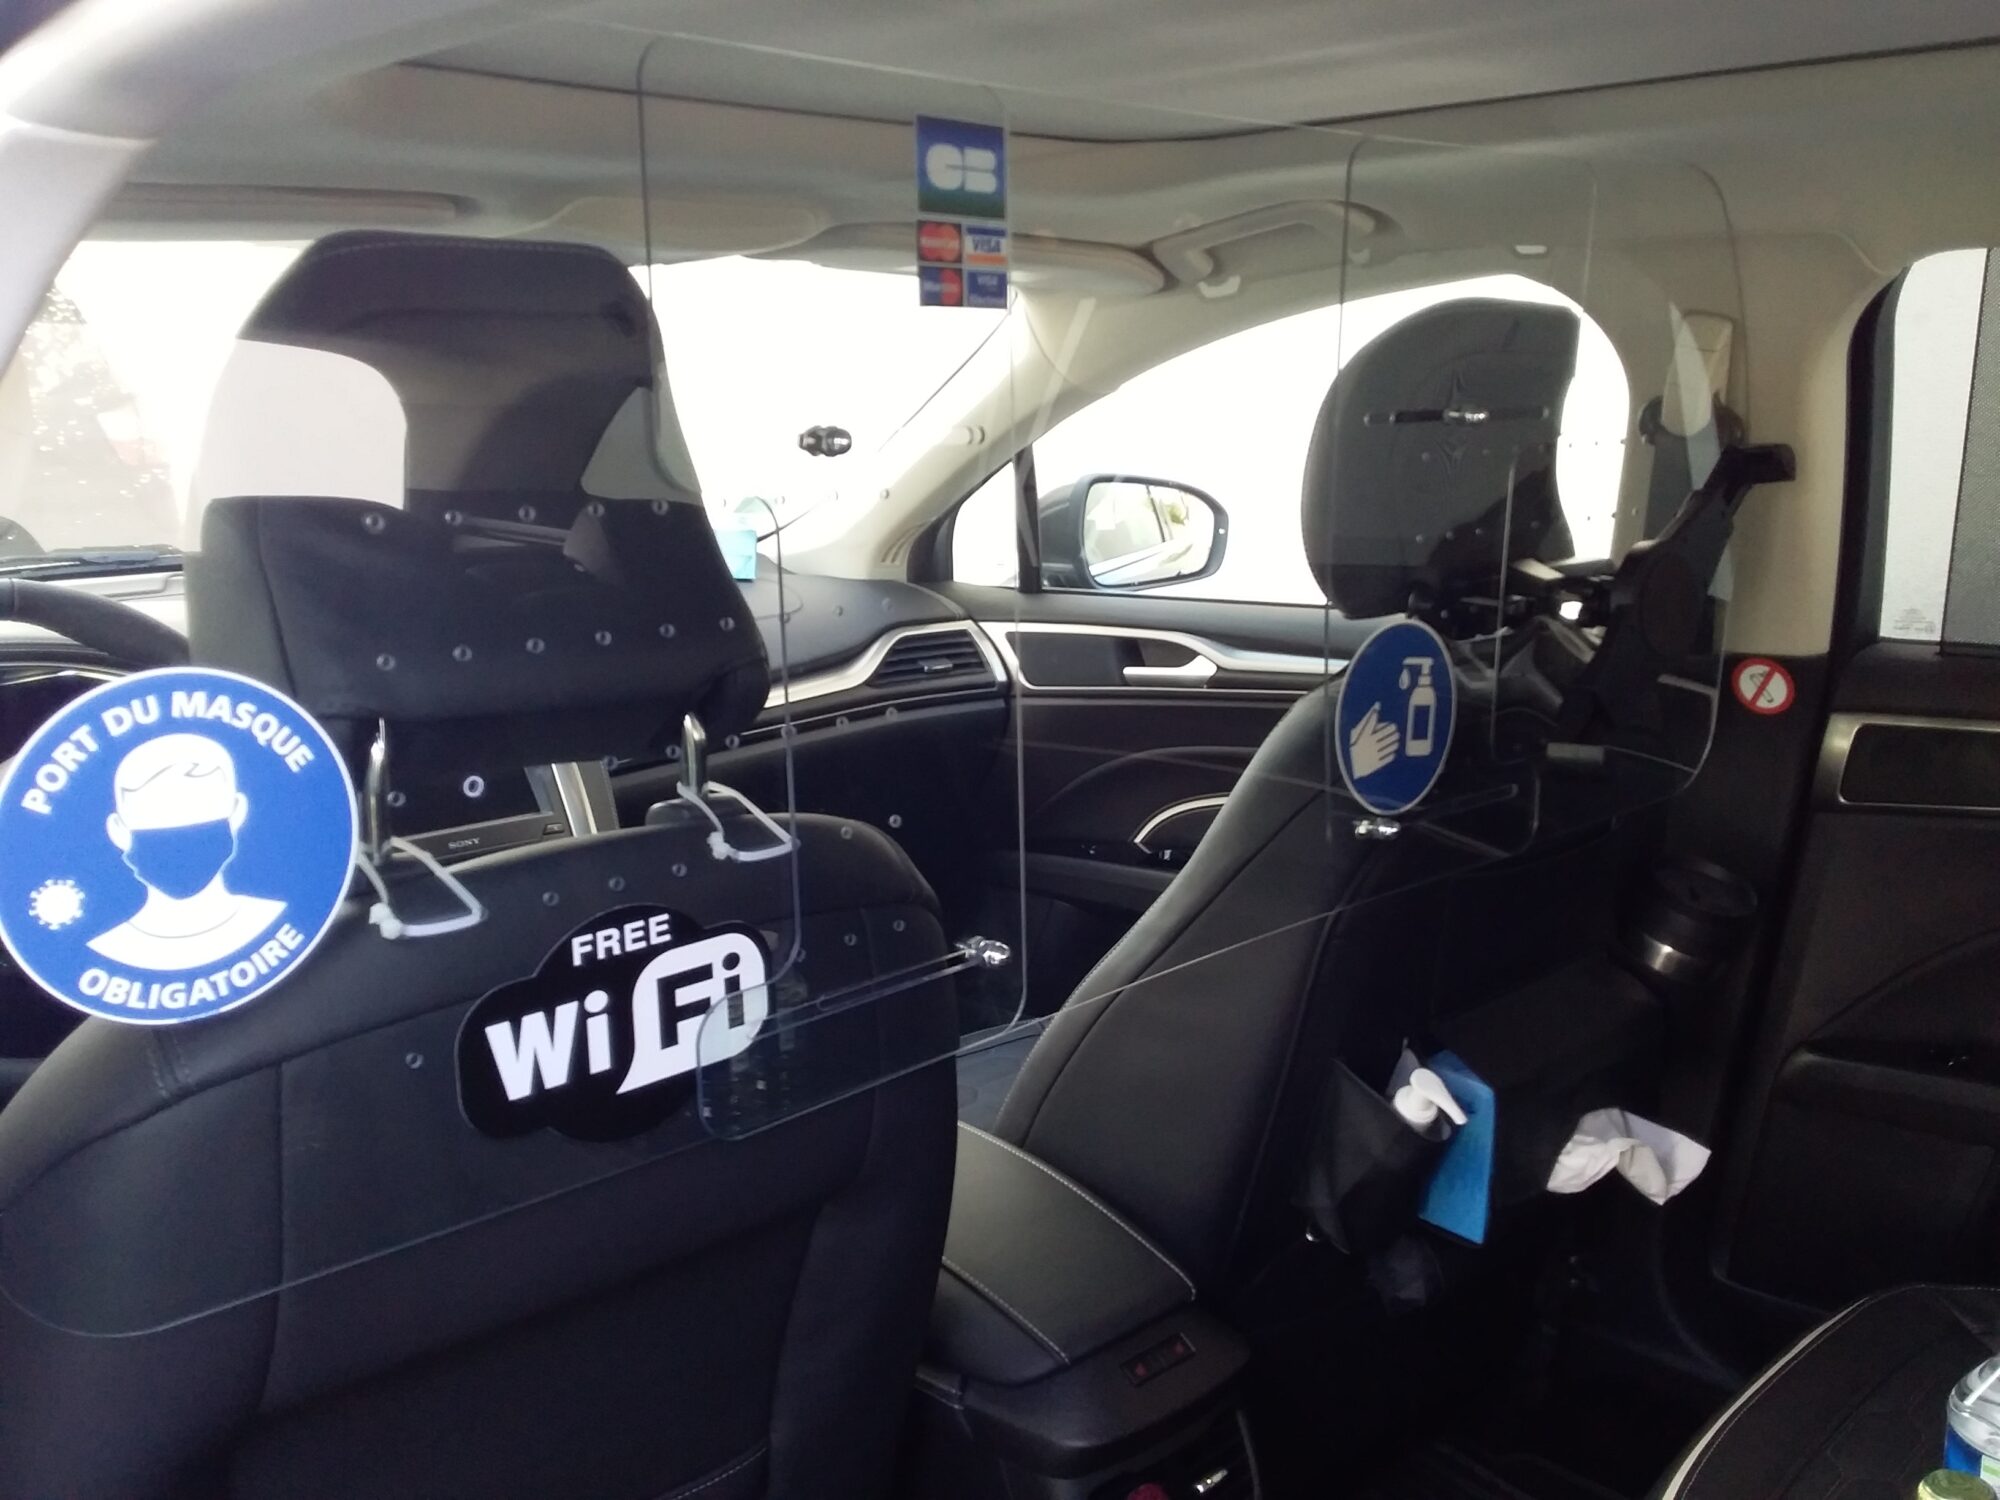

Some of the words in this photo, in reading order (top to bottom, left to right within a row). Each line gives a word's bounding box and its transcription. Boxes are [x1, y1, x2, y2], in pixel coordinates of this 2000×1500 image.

[972, 236, 1002, 253] VISA
[21, 724, 101, 815] PORT
[101, 694, 161, 738] DU
[170, 690, 316, 774] MASQUE
[447, 837, 481, 850] SONY
[78, 923, 306, 1010] OBLIGATOIRE
[571, 912, 673, 968] FREE
